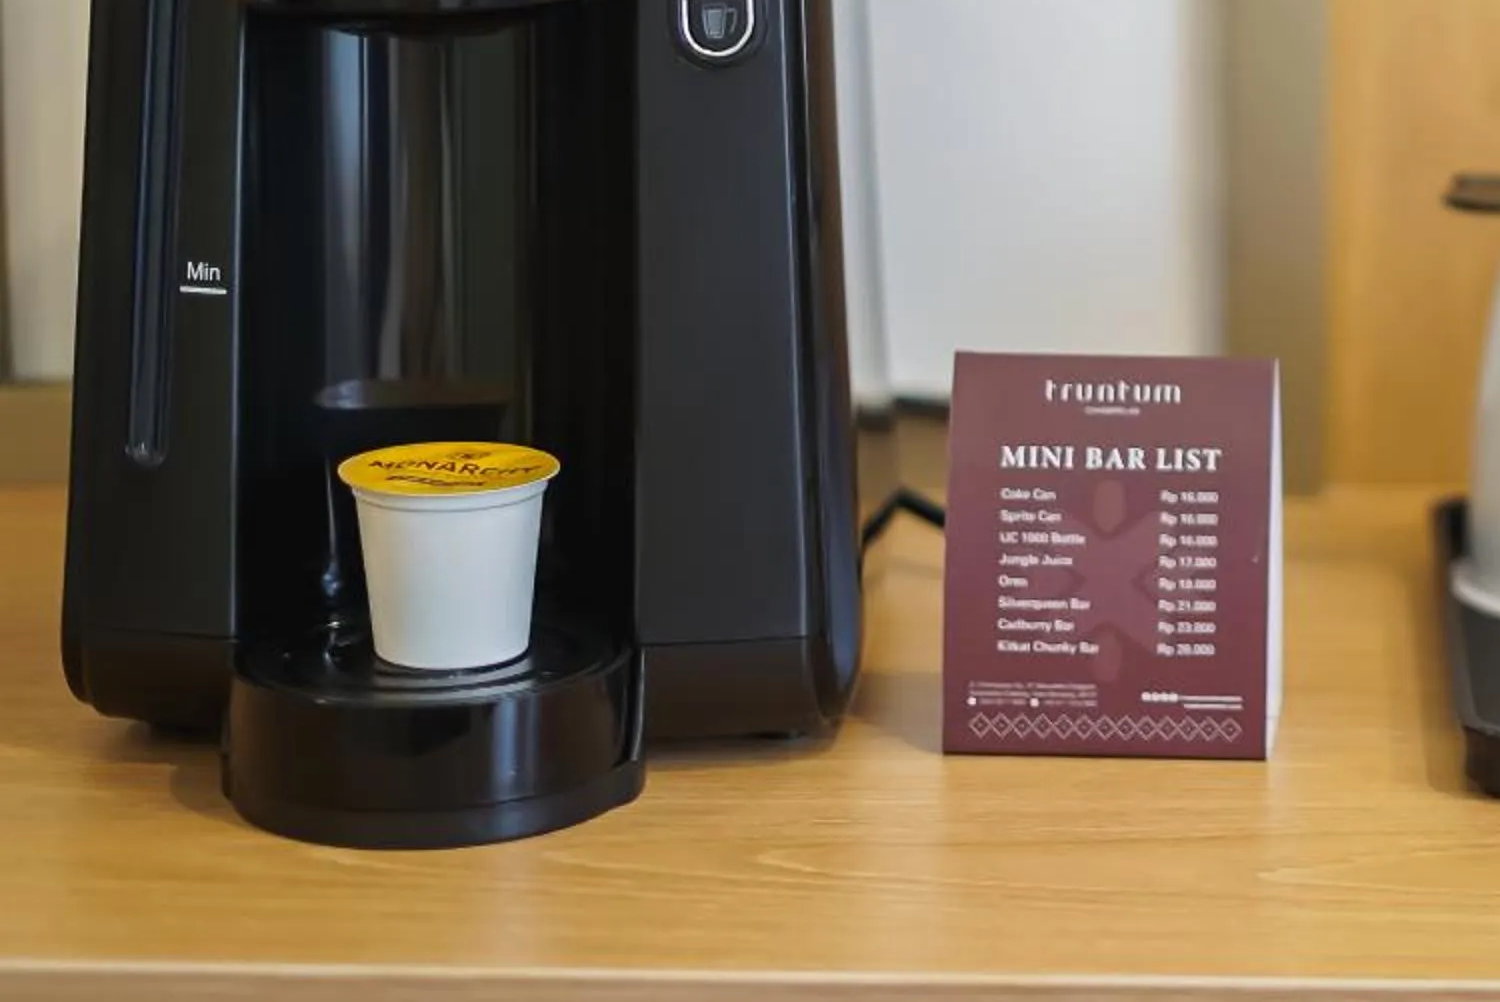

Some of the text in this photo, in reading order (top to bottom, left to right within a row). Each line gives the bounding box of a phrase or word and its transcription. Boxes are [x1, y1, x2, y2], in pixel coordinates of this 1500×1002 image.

[187, 261, 221, 281] Min
[1045, 379, 1181, 404] truntum
[1001, 445, 1222, 472] MINI BAR LIST
[1033, 487, 1057, 502] Can
[1160, 489, 1179, 505] Rp
[1000, 509, 1062, 524] Sprite Can
[1160, 511, 1178, 527] Rp
[1160, 533, 1177, 548] Rp
[999, 553, 1073, 567] Jungle Juice
[1159, 555, 1177, 570] Rp
[1159, 577, 1177, 592] Rp
[1070, 597, 1092, 610] Bar
[1158, 599, 1176, 613] Rp
[1054, 619, 1076, 632] Bar
[1158, 621, 1176, 635] Rp
[1032, 640, 1078, 656] Chunky
[1079, 641, 1100, 655] Bar
[1157, 643, 1175, 657] Rp
